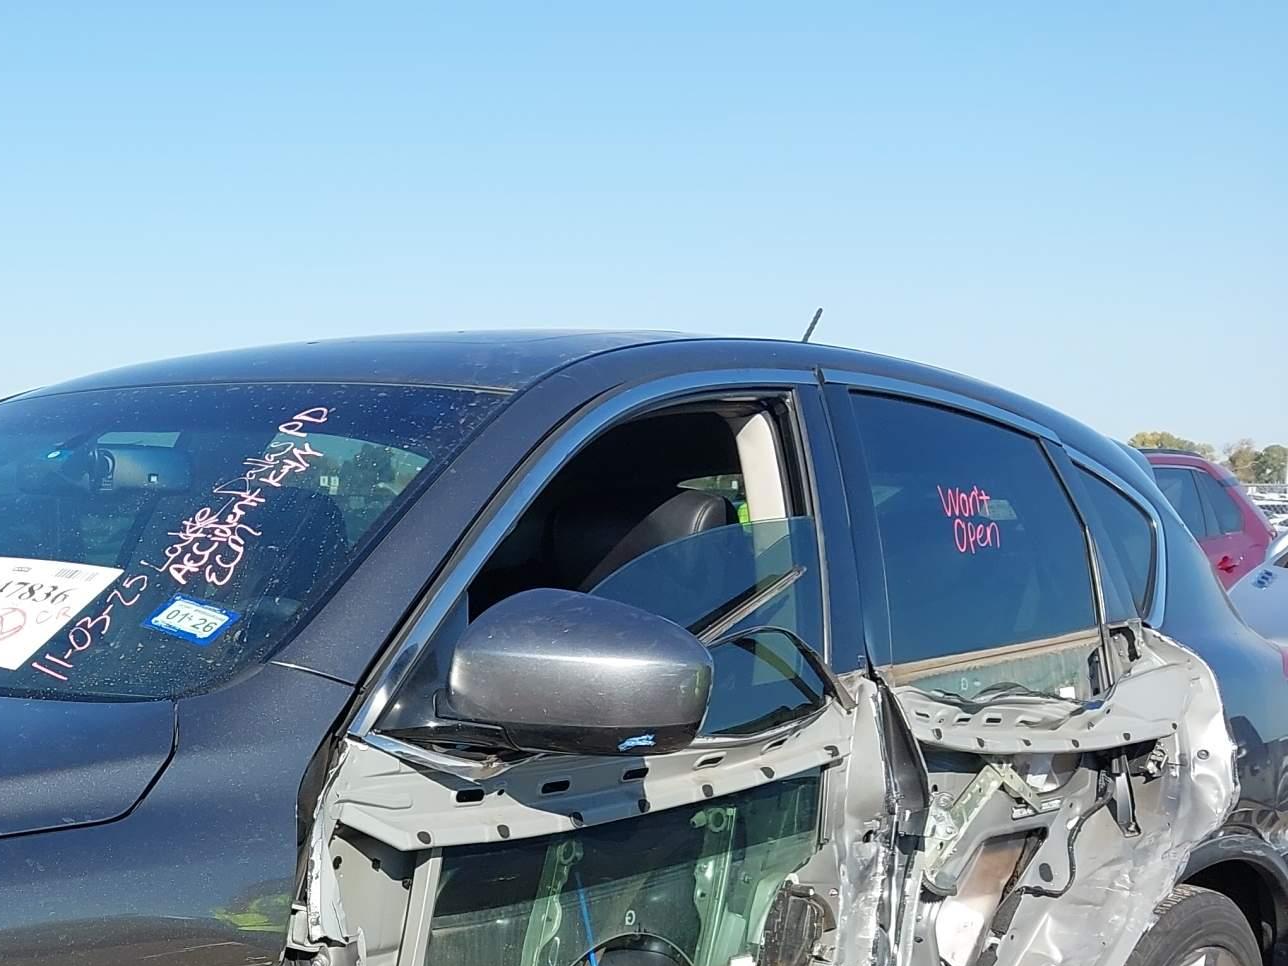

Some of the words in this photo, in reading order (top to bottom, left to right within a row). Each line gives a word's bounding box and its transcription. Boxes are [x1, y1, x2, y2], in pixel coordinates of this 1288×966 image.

[32, 575, 148, 680] 11-03-25
[213, 442, 294, 494] Dallas
[278, 407, 330, 437] PD
[953, 518, 1001, 554] Open
[166, 609, 189, 623] 01
[191, 618, 218, 633] 26
